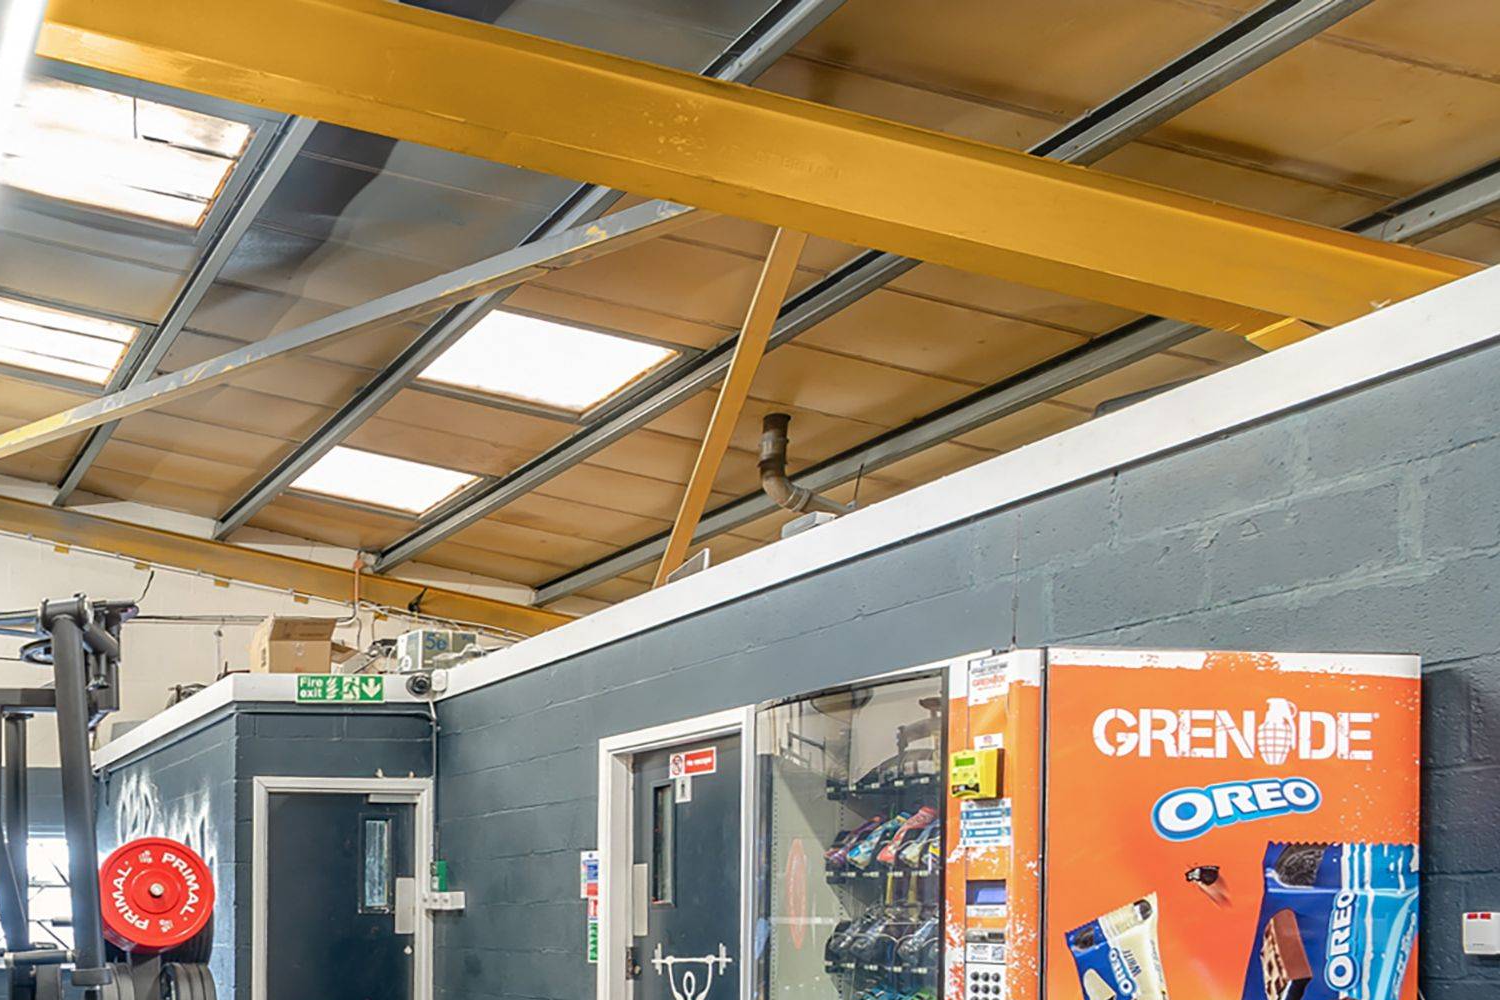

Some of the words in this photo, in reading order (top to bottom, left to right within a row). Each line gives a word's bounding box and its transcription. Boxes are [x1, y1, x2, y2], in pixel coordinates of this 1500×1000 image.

[300, 677, 323, 688] Fire
[300, 688, 322, 698] exit
[1092, 699, 1377, 765] GRENADE
[1158, 780, 1317, 833] OREO
[112, 866, 150, 931] PRIMAL
[161, 852, 200, 915] PRIMAL
[1328, 888, 1355, 988] OREO
